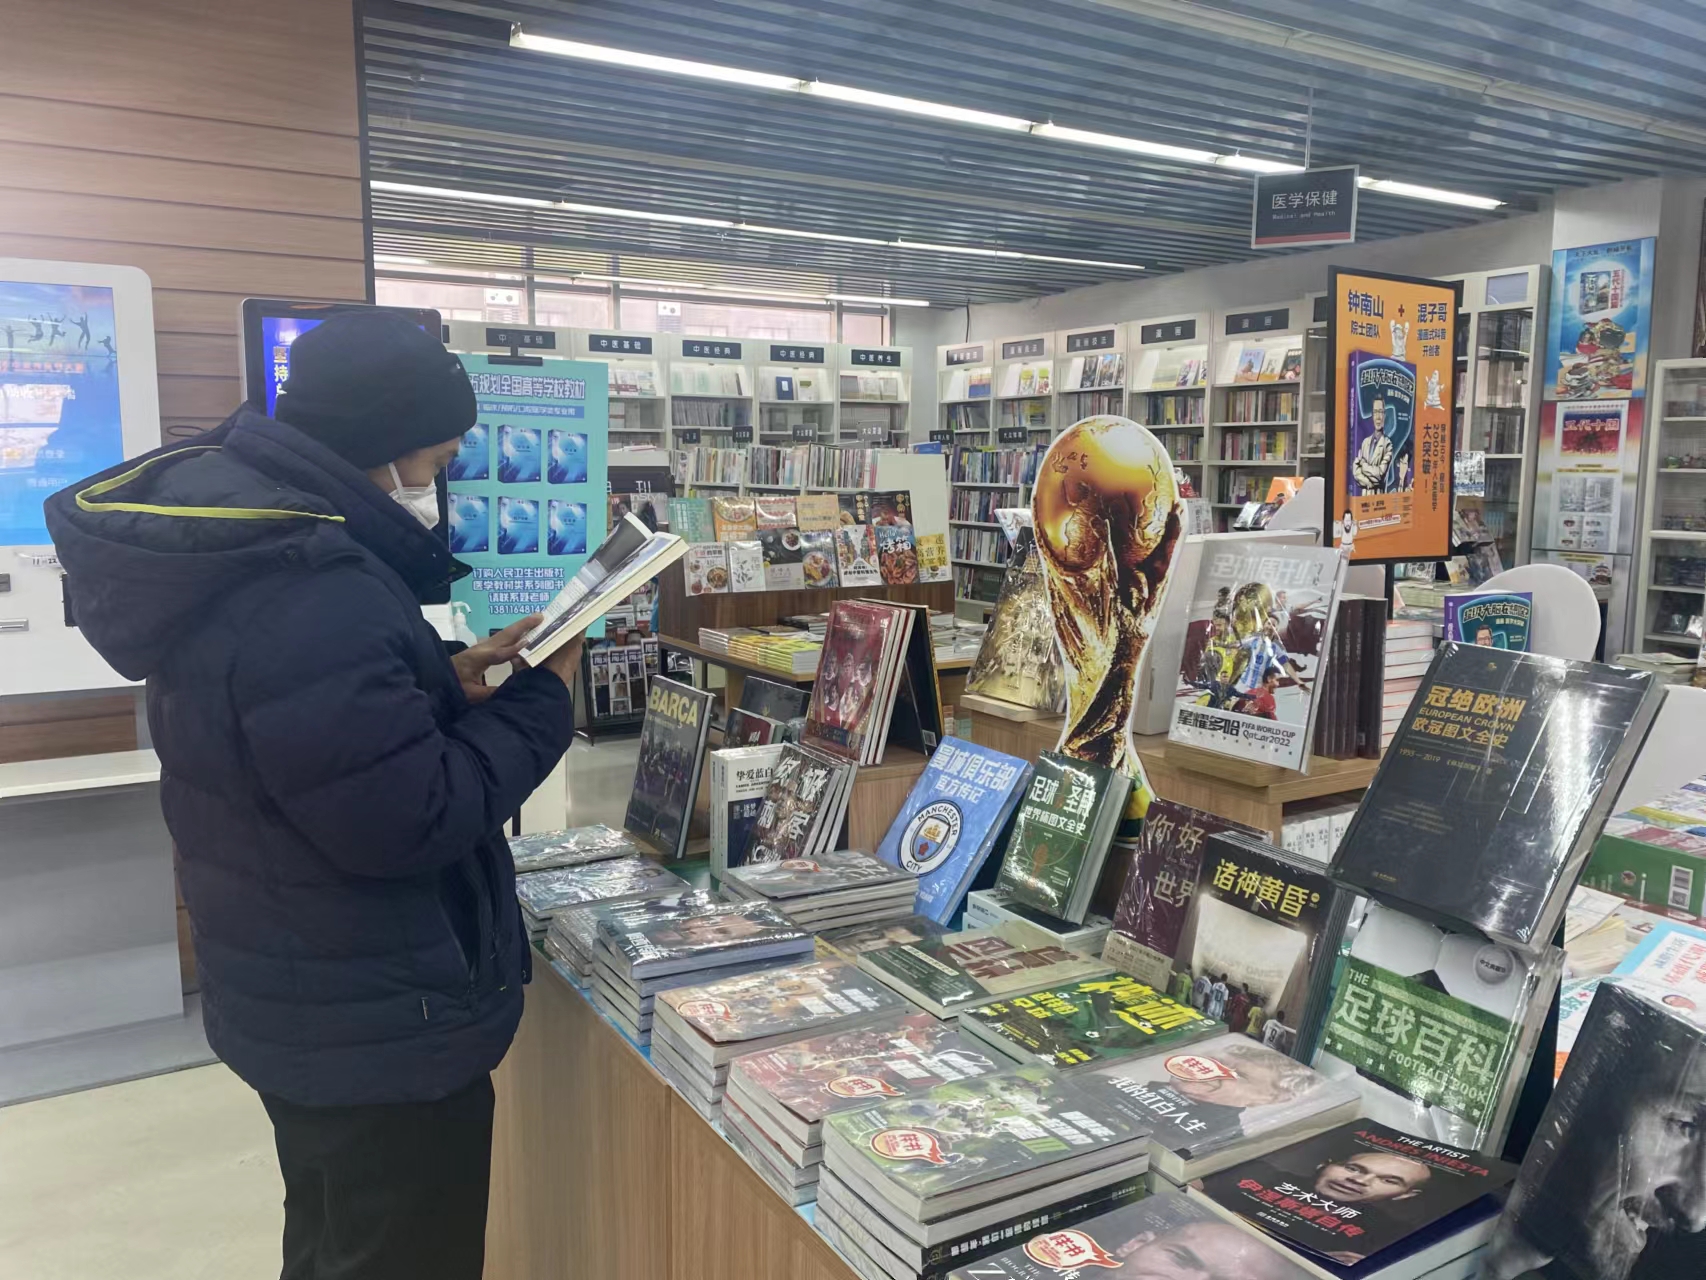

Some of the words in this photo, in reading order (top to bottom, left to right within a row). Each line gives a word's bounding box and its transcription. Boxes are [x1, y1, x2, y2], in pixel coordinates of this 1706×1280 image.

[1271, 189, 1338, 210] 医学保健
[1347, 289, 1384, 319] 钟南山
[1417, 302, 1448, 324] 混子哥
[498, 334, 544, 345] 中基础
[1350, 320, 1381, 339] 院士团队
[600, 339, 642, 350] 中医基础
[692, 344, 731, 355] 中医经典
[779, 349, 815, 360] 中医经典
[859, 353, 893, 364] 中医养生
[880, 535, 911, 554] 烤箱
[472, 567, 565, 579] 订购人民卫生出版社
[472, 580, 565, 591] 医学教材类系列图书
[1424, 685, 1527, 722] 冠绝欧洲
[1177, 709, 1240, 737] 星耀多哈
[1241, 721, 1255, 730] FIFA
[1256, 724, 1280, 736] WORLD
[1281, 731, 1296, 739] CUP
[1419, 707, 1472, 724] EUROPEAN
[1474, 717, 1515, 732] CROWN
[1411, 717, 1509, 749] 欧冠图文全史
[929, 743, 1017, 792] 曼城俱乐部
[935, 774, 987, 804] 官方传记
[917, 805, 958, 837] MANCHESTER
[1024, 805, 1087, 836] 世界杯图文全史
[1148, 813, 1206, 854] 你好
[906, 860, 923, 872] CITY
[1212, 858, 1309, 918] 诸神黄昏
[1349, 969, 1370, 986] THE
[1270, 1028, 1277, 1042] 9
[1335, 983, 1497, 1084] 足球百科
[1389, 1049, 1450, 1093] FOOTBALL
[1108, 1076, 1207, 1135] 我的红白人生
[1397, 1135, 1422, 1147] THE
[1422, 1143, 1470, 1160] ARTIST
[1423, 1152, 1490, 1177] INIESTA
[1237, 1178, 1365, 1238] 伊涅斯塔自传
[1274, 1181, 1362, 1219] 艺术大师
[1048, 1233, 1086, 1258] 样书
